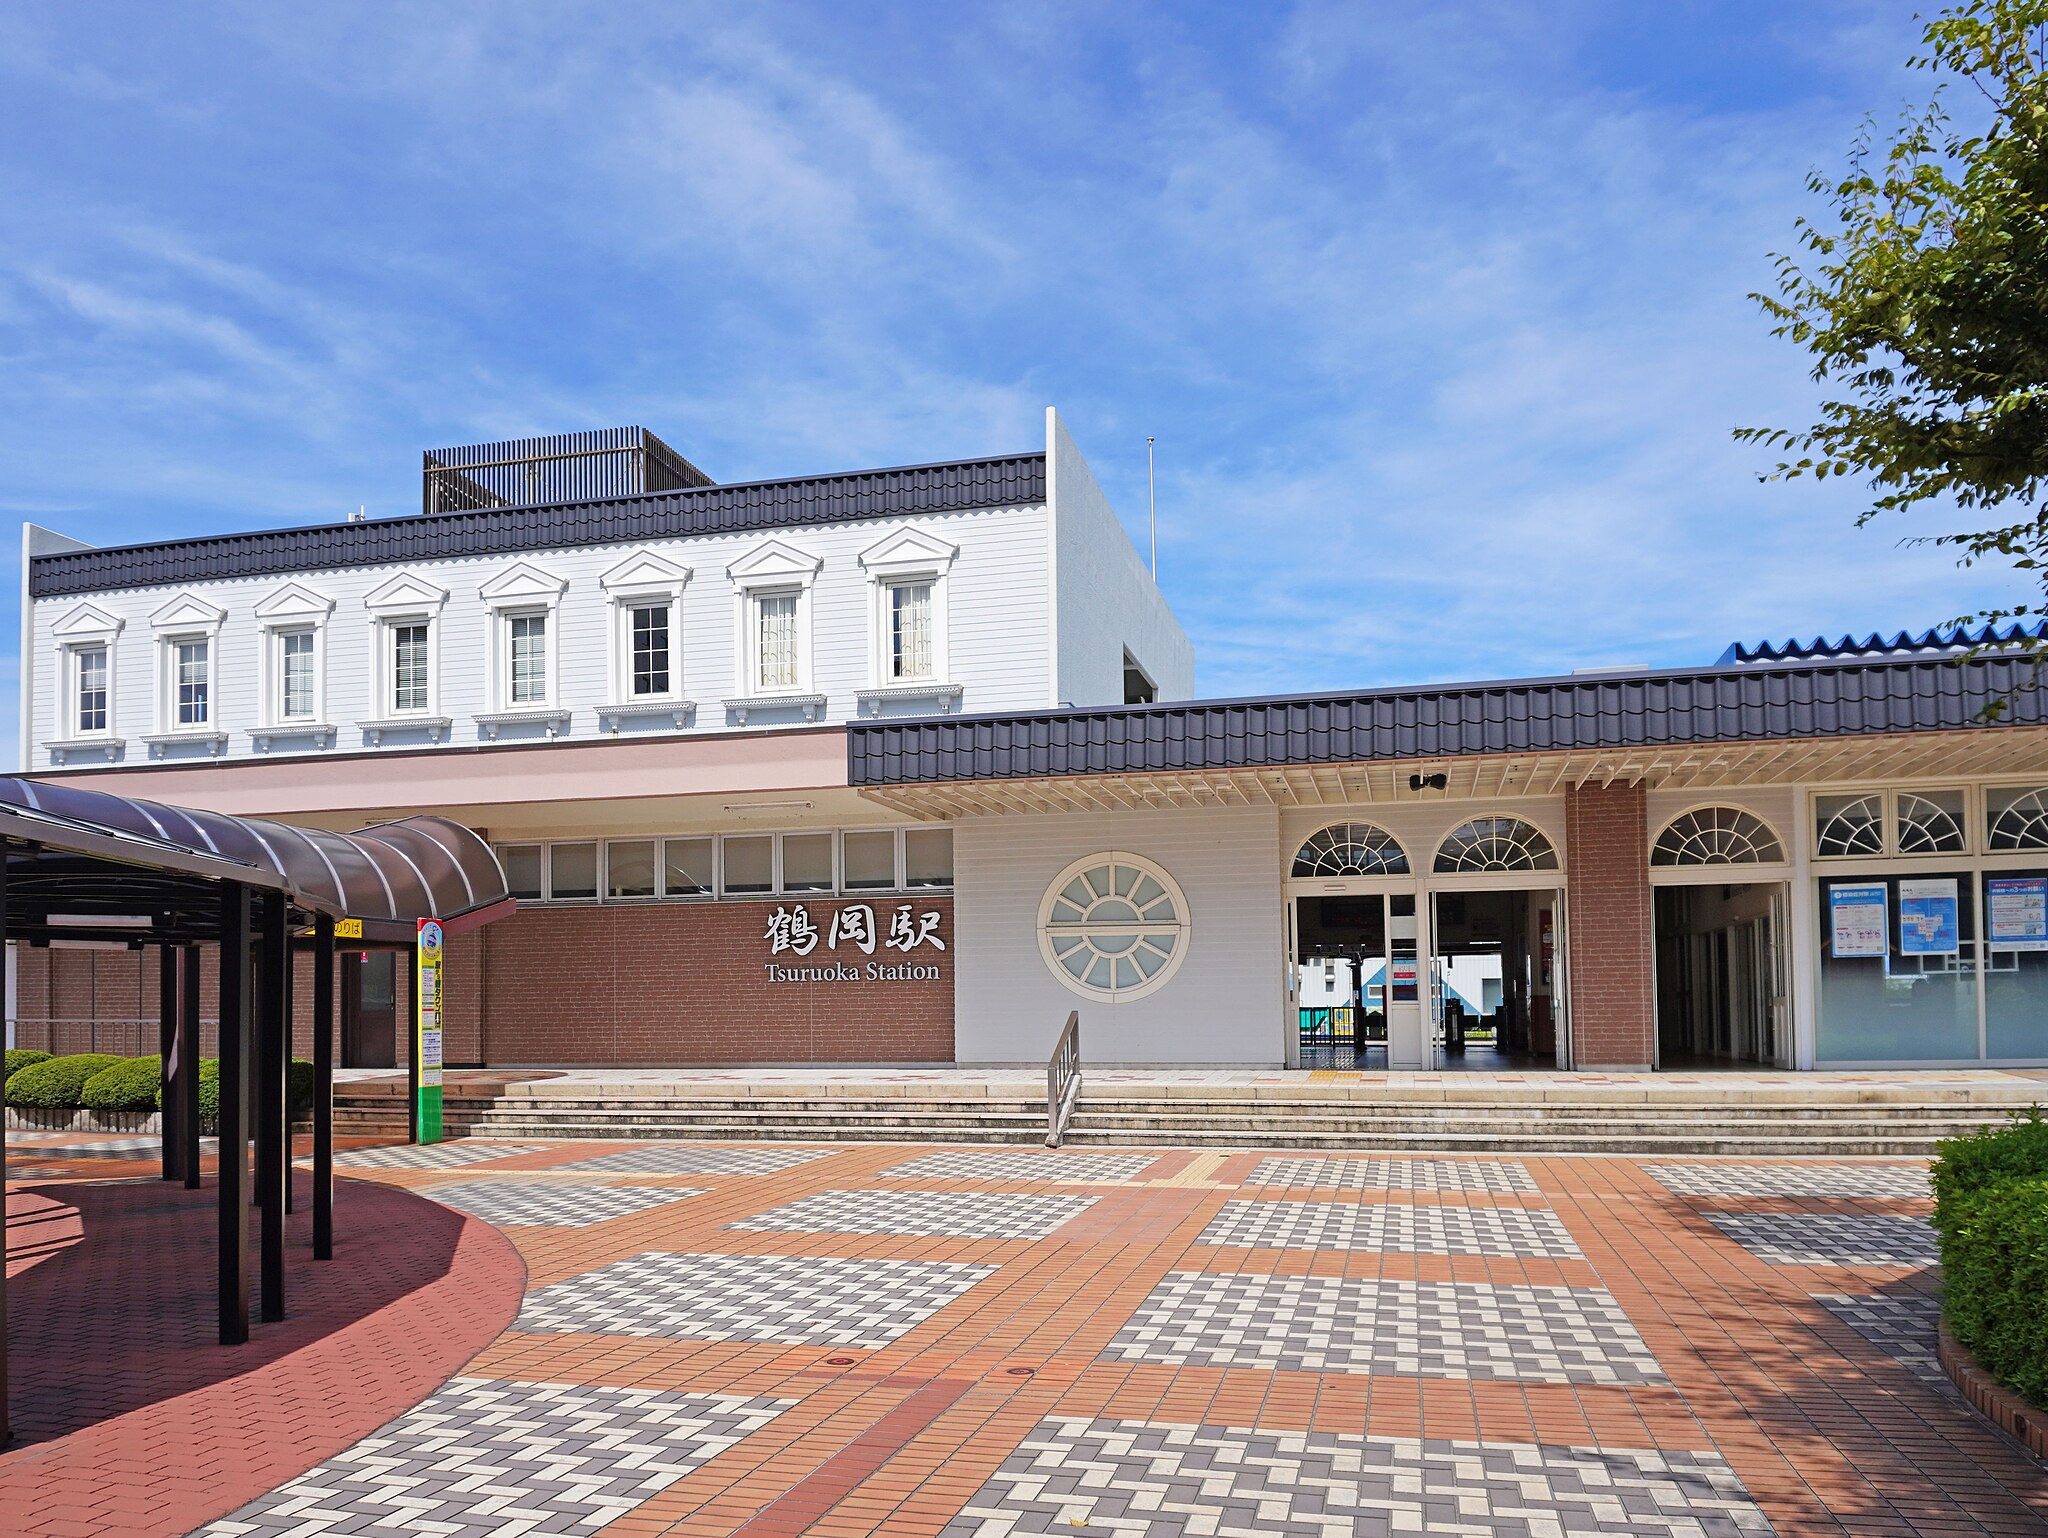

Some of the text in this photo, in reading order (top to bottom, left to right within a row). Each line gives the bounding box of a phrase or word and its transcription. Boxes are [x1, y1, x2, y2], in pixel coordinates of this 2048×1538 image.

[763, 904, 946, 956] 鶴岡駅
[764, 961, 940, 982] Tsuruoka Station
